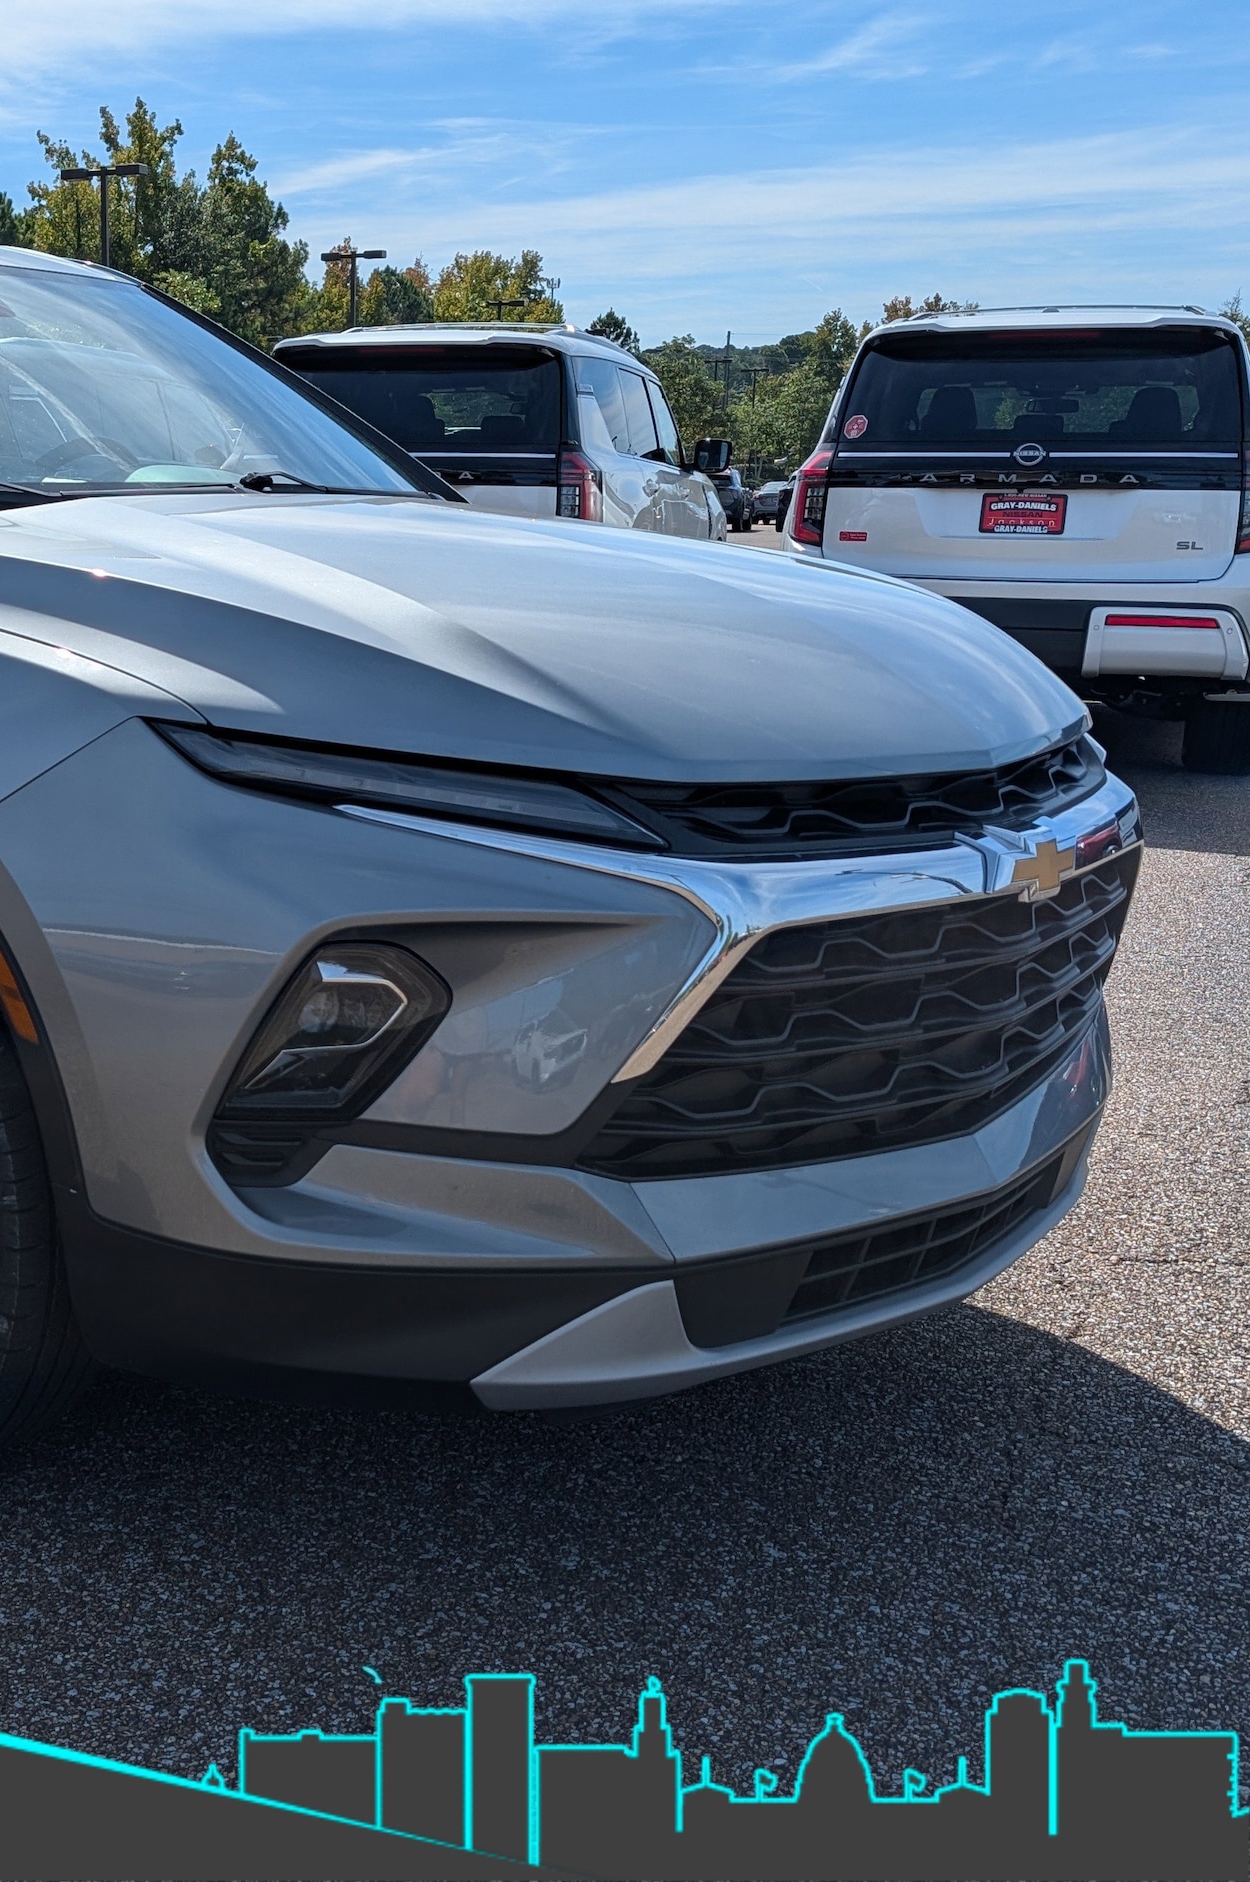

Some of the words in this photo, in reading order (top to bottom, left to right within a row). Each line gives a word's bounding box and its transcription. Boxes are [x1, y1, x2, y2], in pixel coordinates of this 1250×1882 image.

[919, 473, 1140, 485] ARMADA
[990, 501, 1057, 511] GRAY-DANIELS
[994, 525, 1048, 533] GRAY-DANIELS
[1176, 541, 1204, 551] SL
